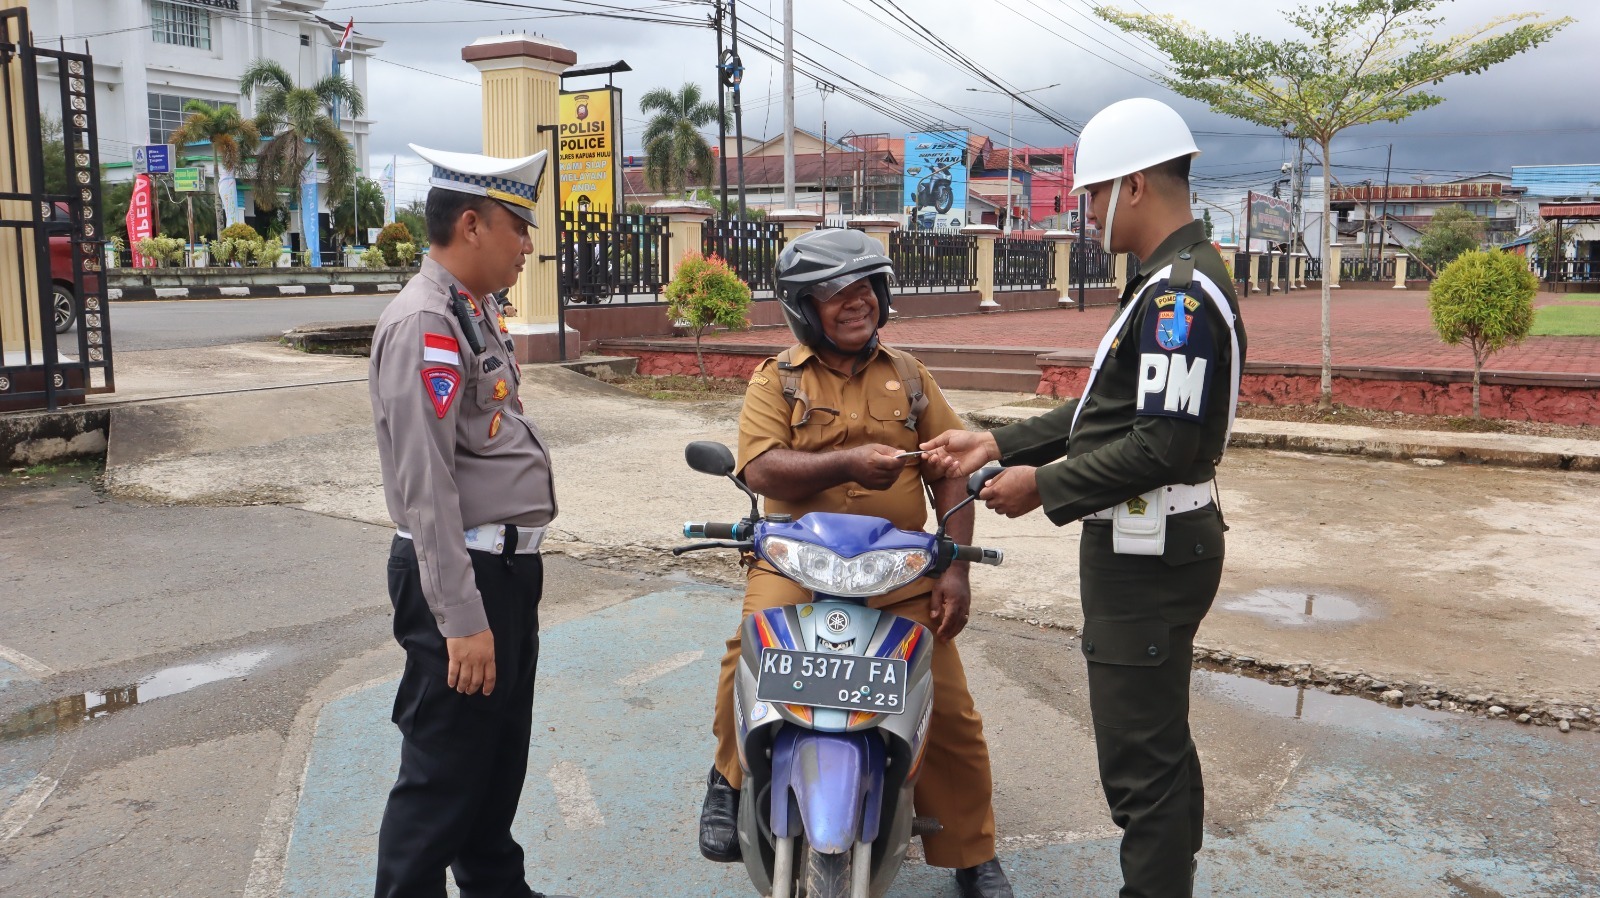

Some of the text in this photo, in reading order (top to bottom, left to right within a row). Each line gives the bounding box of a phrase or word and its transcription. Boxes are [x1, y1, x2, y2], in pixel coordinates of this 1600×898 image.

[561, 121, 604, 135] POLISI
[561, 137, 605, 151] POLICE
[560, 160, 607, 171] KAMI SIAP
[560, 171, 607, 182] MELAYANI
[571, 183, 597, 192] ANDA
[853, 254, 878, 263] HONDA
[1136, 353, 1208, 416] PM
[764, 653, 897, 684] KB 5377 FA
